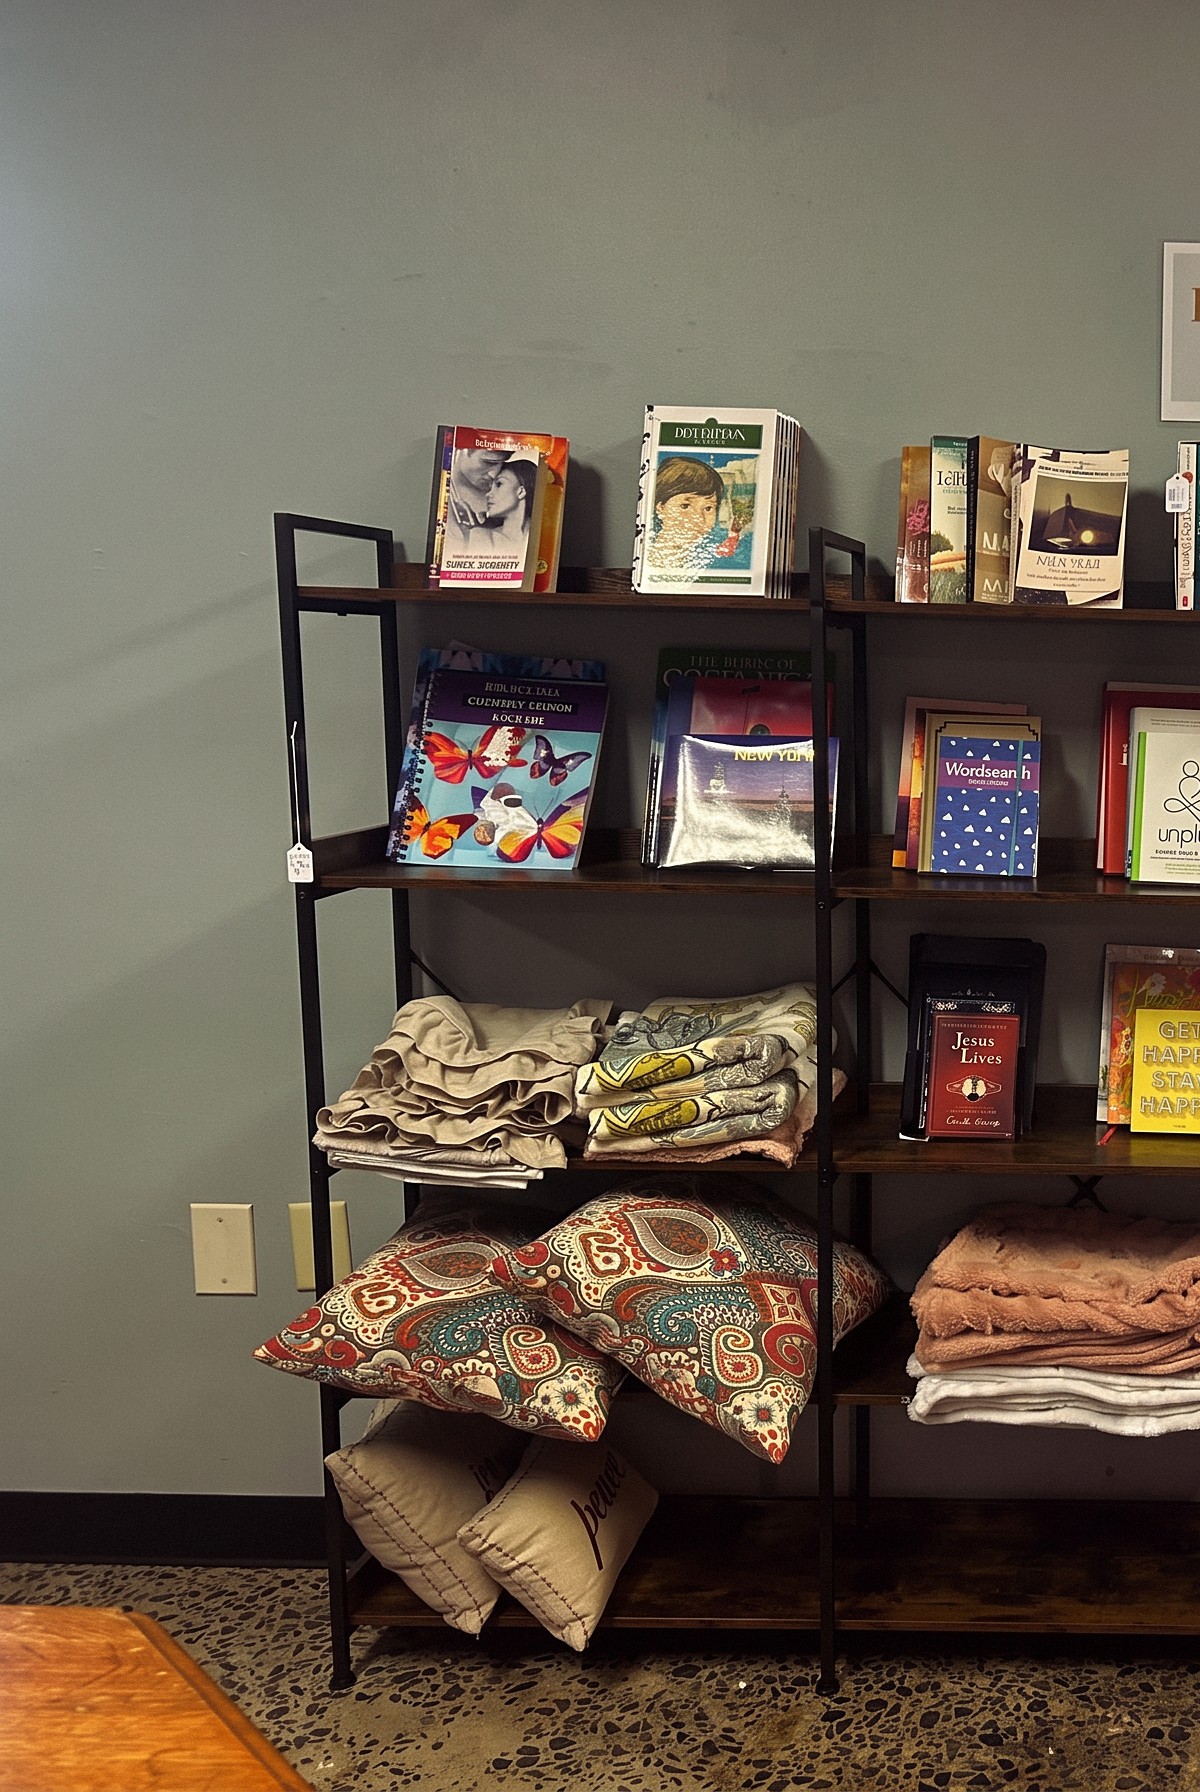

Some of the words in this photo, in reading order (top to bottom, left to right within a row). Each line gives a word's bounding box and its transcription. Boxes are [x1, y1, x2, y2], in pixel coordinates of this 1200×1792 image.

[734, 750, 774, 761] NEW
[951, 1031, 995, 1050] Jesus
[960, 1047, 1002, 1065] Lives
